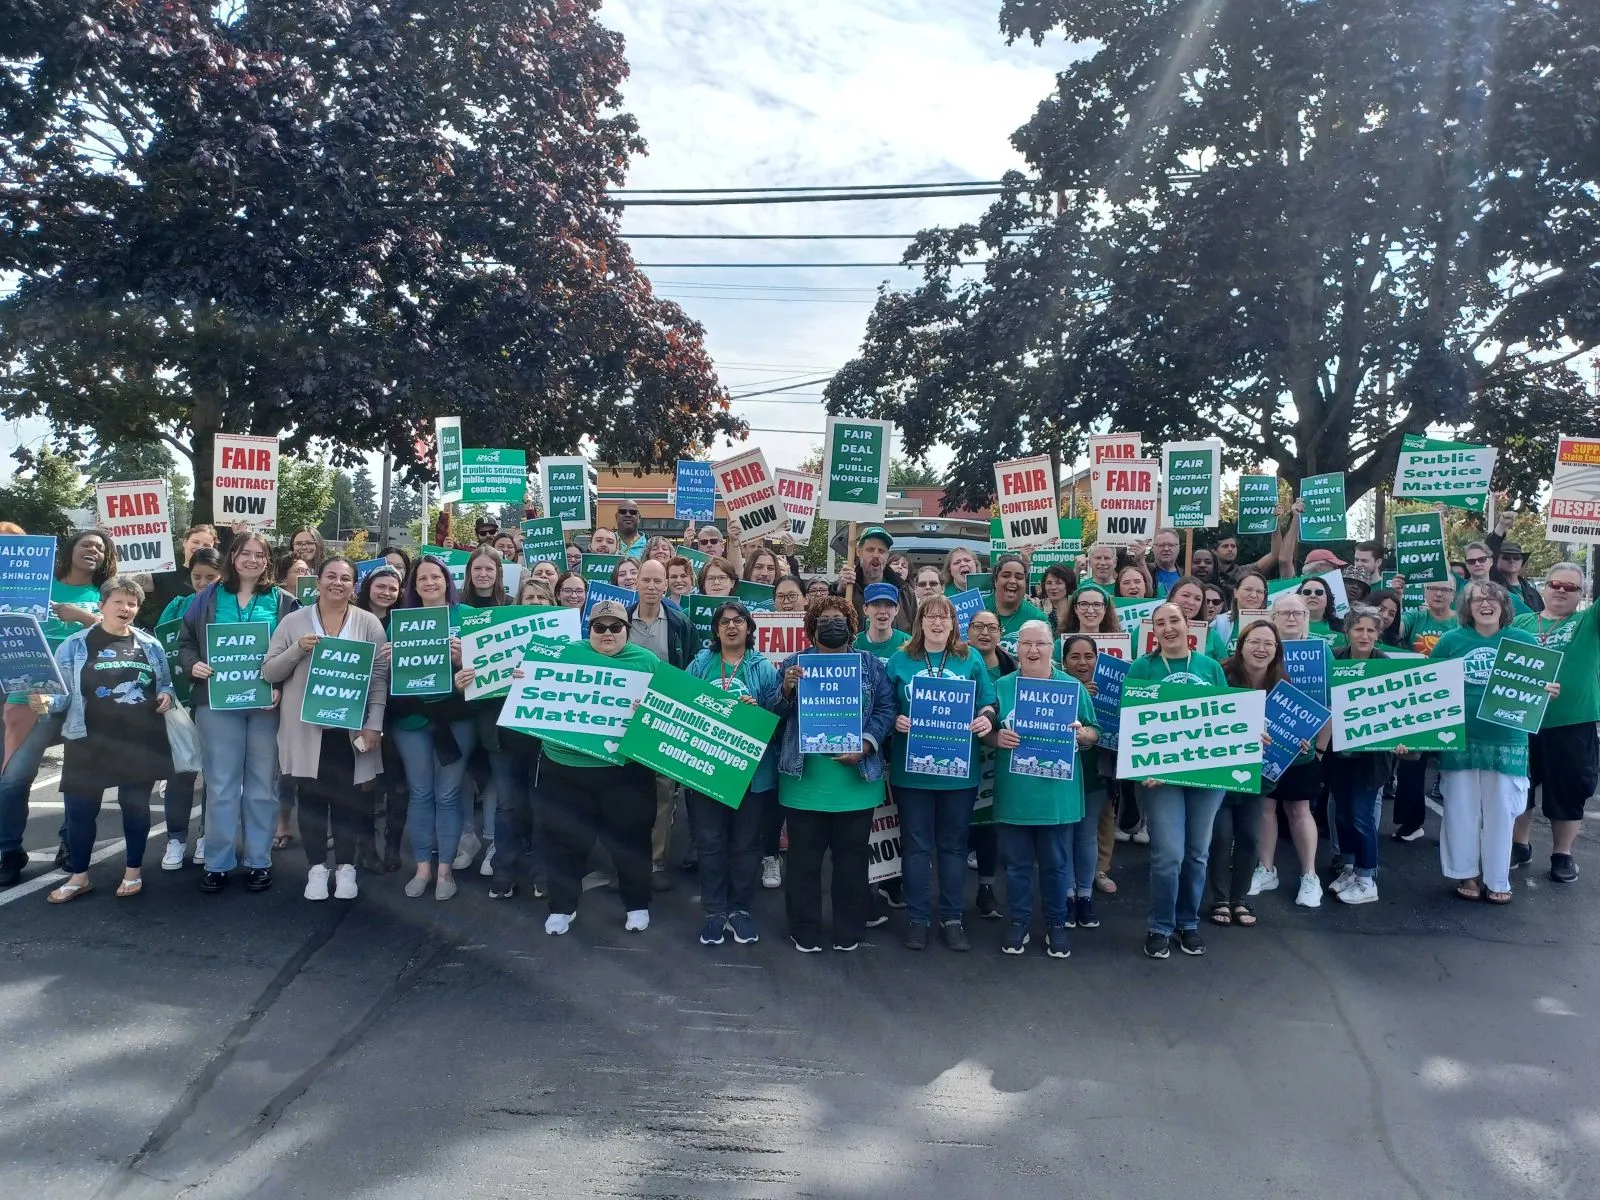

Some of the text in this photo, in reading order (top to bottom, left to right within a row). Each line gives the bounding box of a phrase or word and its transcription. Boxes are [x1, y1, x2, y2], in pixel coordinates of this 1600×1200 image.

[443, 435, 456, 444] FAIR
[843, 429, 873, 440] FAIR
[841, 443, 873, 454] DEAL
[1095, 443, 1135, 465] FAIR
[221, 446, 271, 472] FAIR
[1409, 452, 1476, 465] Public
[1562, 453, 1583, 461] State
[469, 465, 525, 475] public services
[838, 464, 873, 473] PUBLIC
[1174, 459, 1204, 469] FAIR
[679, 468, 713, 477] WALKOUT
[720, 461, 766, 494] FAIR
[831, 474, 879, 484] WORKERS
[1169, 473, 1212, 481] CONTRACT
[1403, 467, 1482, 478] Service
[215, 475, 276, 491] CONTRACT
[486, 476, 521, 485] employee
[1002, 468, 1048, 496] FAIR
[1106, 470, 1152, 492] FAIR
[1244, 483, 1270, 491] FAIR
[1402, 479, 1488, 491] Matters
[471, 486, 507, 494] contracts
[777, 478, 814, 501] FAIR
[1172, 486, 1208, 495] NOW!
[1302, 486, 1342, 497] DESERVE
[106, 492, 160, 518] FAIR
[223, 495, 267, 515] NOW
[552, 495, 582, 503] NOW!
[726, 485, 776, 512] CONTRACT
[1100, 499, 1155, 511] CONTRACT
[1310, 497, 1331, 506] TIME
[783, 502, 815, 516] NTRACT
[1001, 497, 1054, 515] CONTRACT
[1242, 507, 1276, 515] NOW!
[738, 505, 778, 531] NOW
[1301, 513, 1344, 524] FAMILY
[105, 521, 168, 538] CONTRACT
[526, 526, 554, 537] FAIR
[1010, 516, 1048, 538] NOW
[1107, 516, 1147, 534] NOW
[1400, 523, 1430, 535] FAIR
[1551, 524, 1570, 534] OUR
[524, 539, 564, 549] CONTRACT
[992, 540, 1080, 550] Fun ices
[1397, 538, 1442, 548] CONTRACT
[117, 541, 162, 562] NOW
[529, 552, 563, 563] NOW!
[1400, 552, 1440, 564] NOW!
[9, 559, 30, 568] FOR
[1032, 553, 1076, 564] employee
[587, 564, 615, 573] FAIR
[302, 587, 319, 598] FA
[590, 590, 631, 607] WALKOUT
[956, 598, 979, 611] KOUT
[695, 606, 716, 617] FA
[958, 612, 969, 620] OR
[399, 619, 437, 632] FAIR
[462, 616, 492, 627] AFSCME
[475, 617, 559, 649] Public
[758, 626, 813, 653] FAIR
[3, 639, 25, 648] FOR
[216, 634, 257, 647] FAIR
[393, 637, 448, 648] CONTRACT
[210, 653, 267, 663] CONTRACT
[320, 648, 361, 665] FAIR
[531, 645, 562, 660] AFSCME
[398, 654, 445, 668] NOW!
[1503, 651, 1545, 671] FAIR
[215, 669, 265, 682] NOW!
[311, 667, 369, 682] CONTRACT
[803, 666, 857, 679] WALKOUT
[1098, 664, 1124, 682] WALKO
[1288, 665, 1305, 673] FOR
[1332, 668, 1365, 677] AFSCME
[406, 679, 436, 689] AFSCME
[534, 667, 627, 688] Public
[1291, 676, 1323, 684] INGTON
[1493, 668, 1550, 688] CONTRACT
[312, 684, 362, 700] NOW!
[820, 682, 839, 692] FOR
[1106, 682, 1120, 693] FOR
[1347, 671, 1438, 701] Public
[520, 687, 632, 708] Service
[801, 696, 859, 705] WASHINGTON
[915, 688, 971, 705] WALKOUT
[1019, 689, 1075, 706] WALKOUT
[1124, 689, 1160, 699] AFSCME
[1491, 684, 1543, 706] NOW!
[693, 693, 733, 717] AFSCME
[932, 706, 951, 716] FOR
[1272, 691, 1321, 728] WALKOUT
[1343, 687, 1450, 722] Service
[515, 705, 633, 729] Matters
[1035, 706, 1054, 717] FOR
[1138, 700, 1237, 726] Public
[1494, 710, 1525, 721] AFSCME
[643, 691, 762, 758] Fund public services
[912, 718, 970, 731] WASHINGTON
[1016, 719, 1073, 733] WASHINGTON
[1278, 712, 1297, 729] FOR
[1344, 704, 1462, 741] Matters
[1131, 721, 1248, 748] Service
[641, 712, 748, 771] & public employee
[658, 741, 716, 776] contracts
[1131, 741, 1260, 769] Matters
